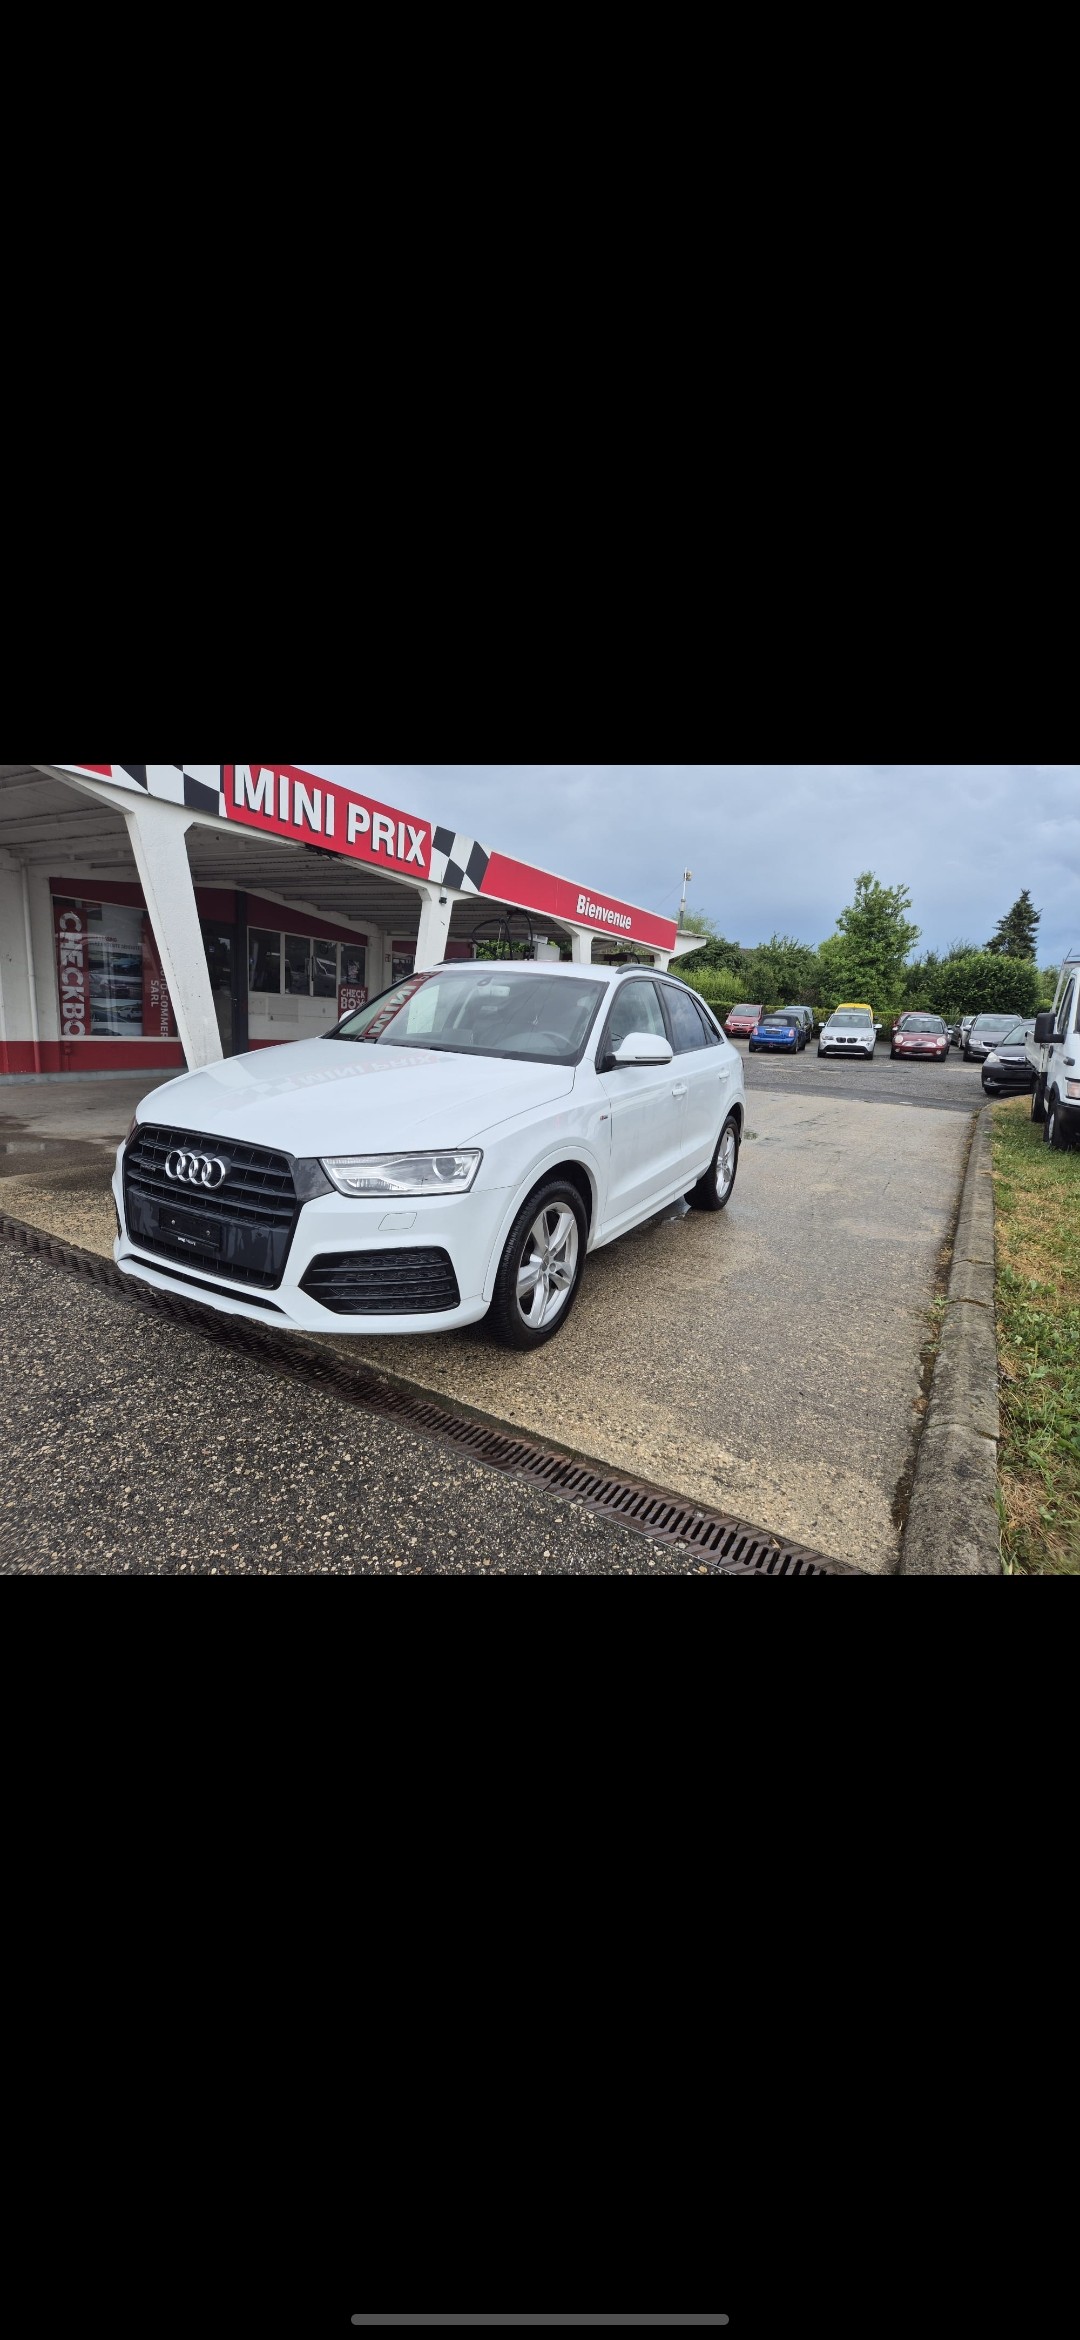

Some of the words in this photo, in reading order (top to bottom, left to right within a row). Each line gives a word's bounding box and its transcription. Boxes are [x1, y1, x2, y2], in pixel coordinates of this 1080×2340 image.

[233, 765, 335, 837] MINI
[346, 802, 427, 867] PRIX
[576, 893, 632, 930] Bienvenue
[150, 980, 159, 1007] SARL
[340, 988, 366, 999] CHECK
